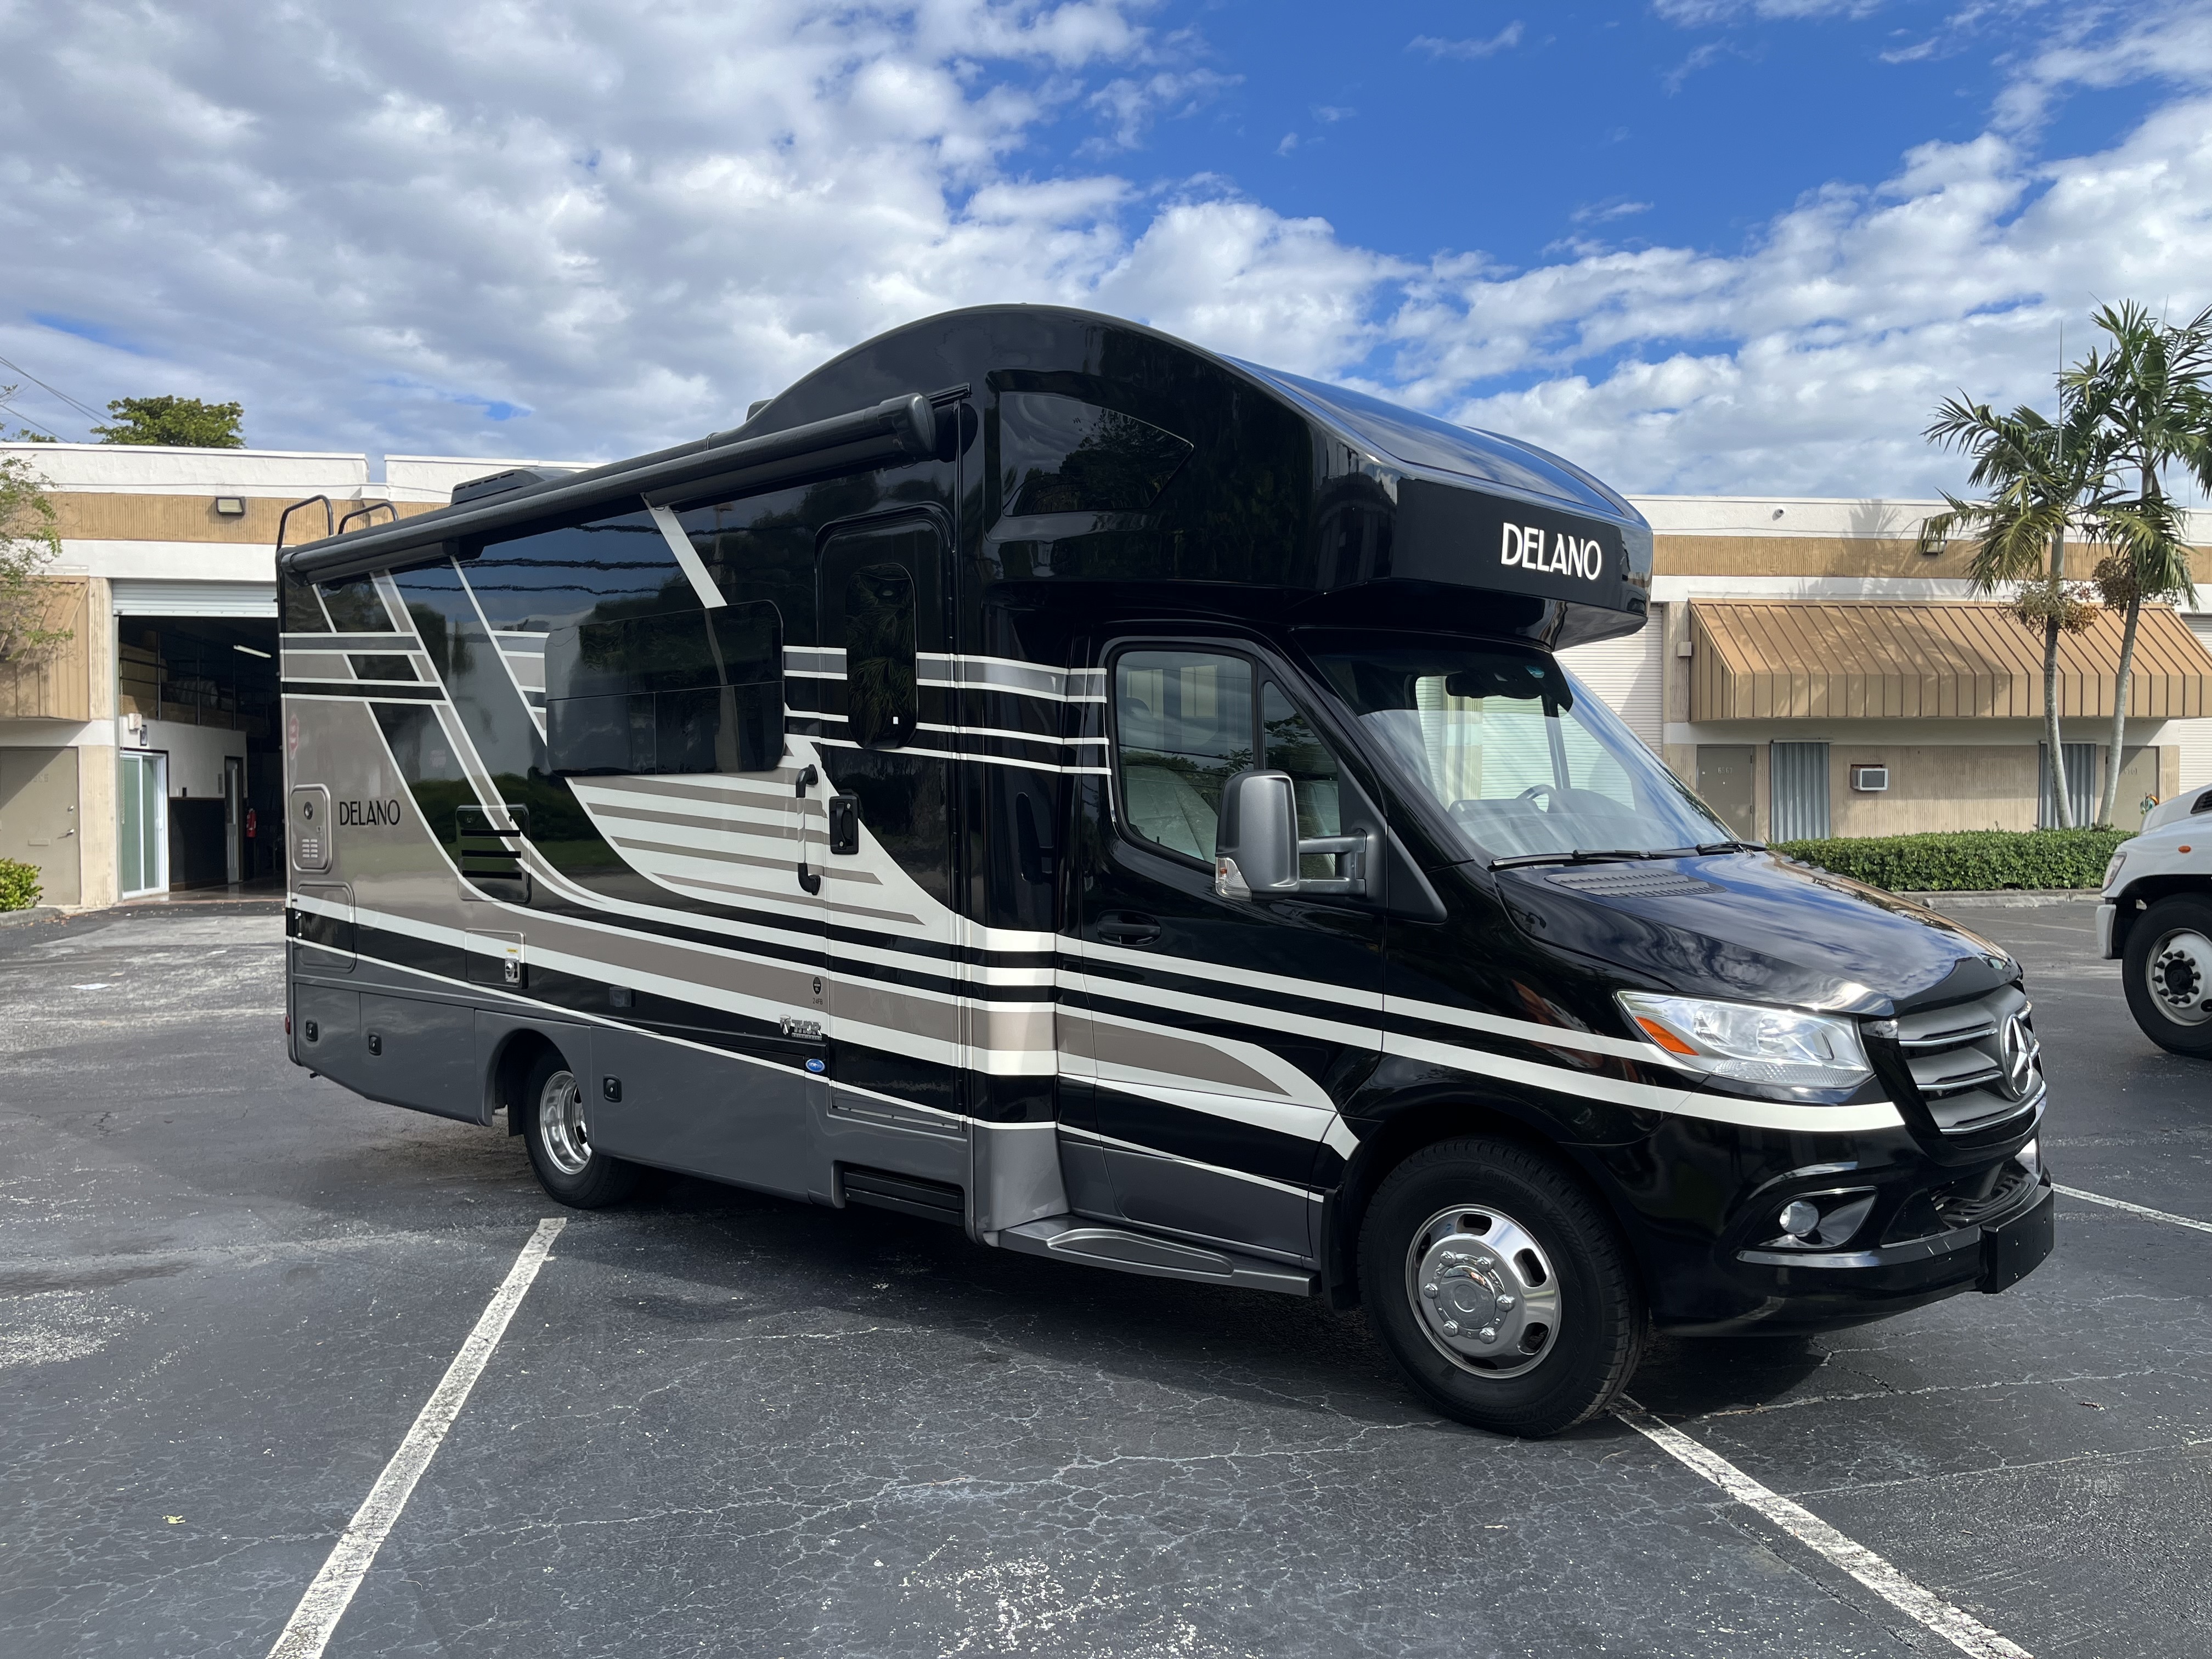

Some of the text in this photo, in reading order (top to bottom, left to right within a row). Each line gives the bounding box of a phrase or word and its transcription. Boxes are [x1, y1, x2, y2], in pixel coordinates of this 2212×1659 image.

[1501, 522, 1602, 580] DELANO
[339, 799, 400, 826] DELANO
[792, 1019, 822, 1036] THOR
